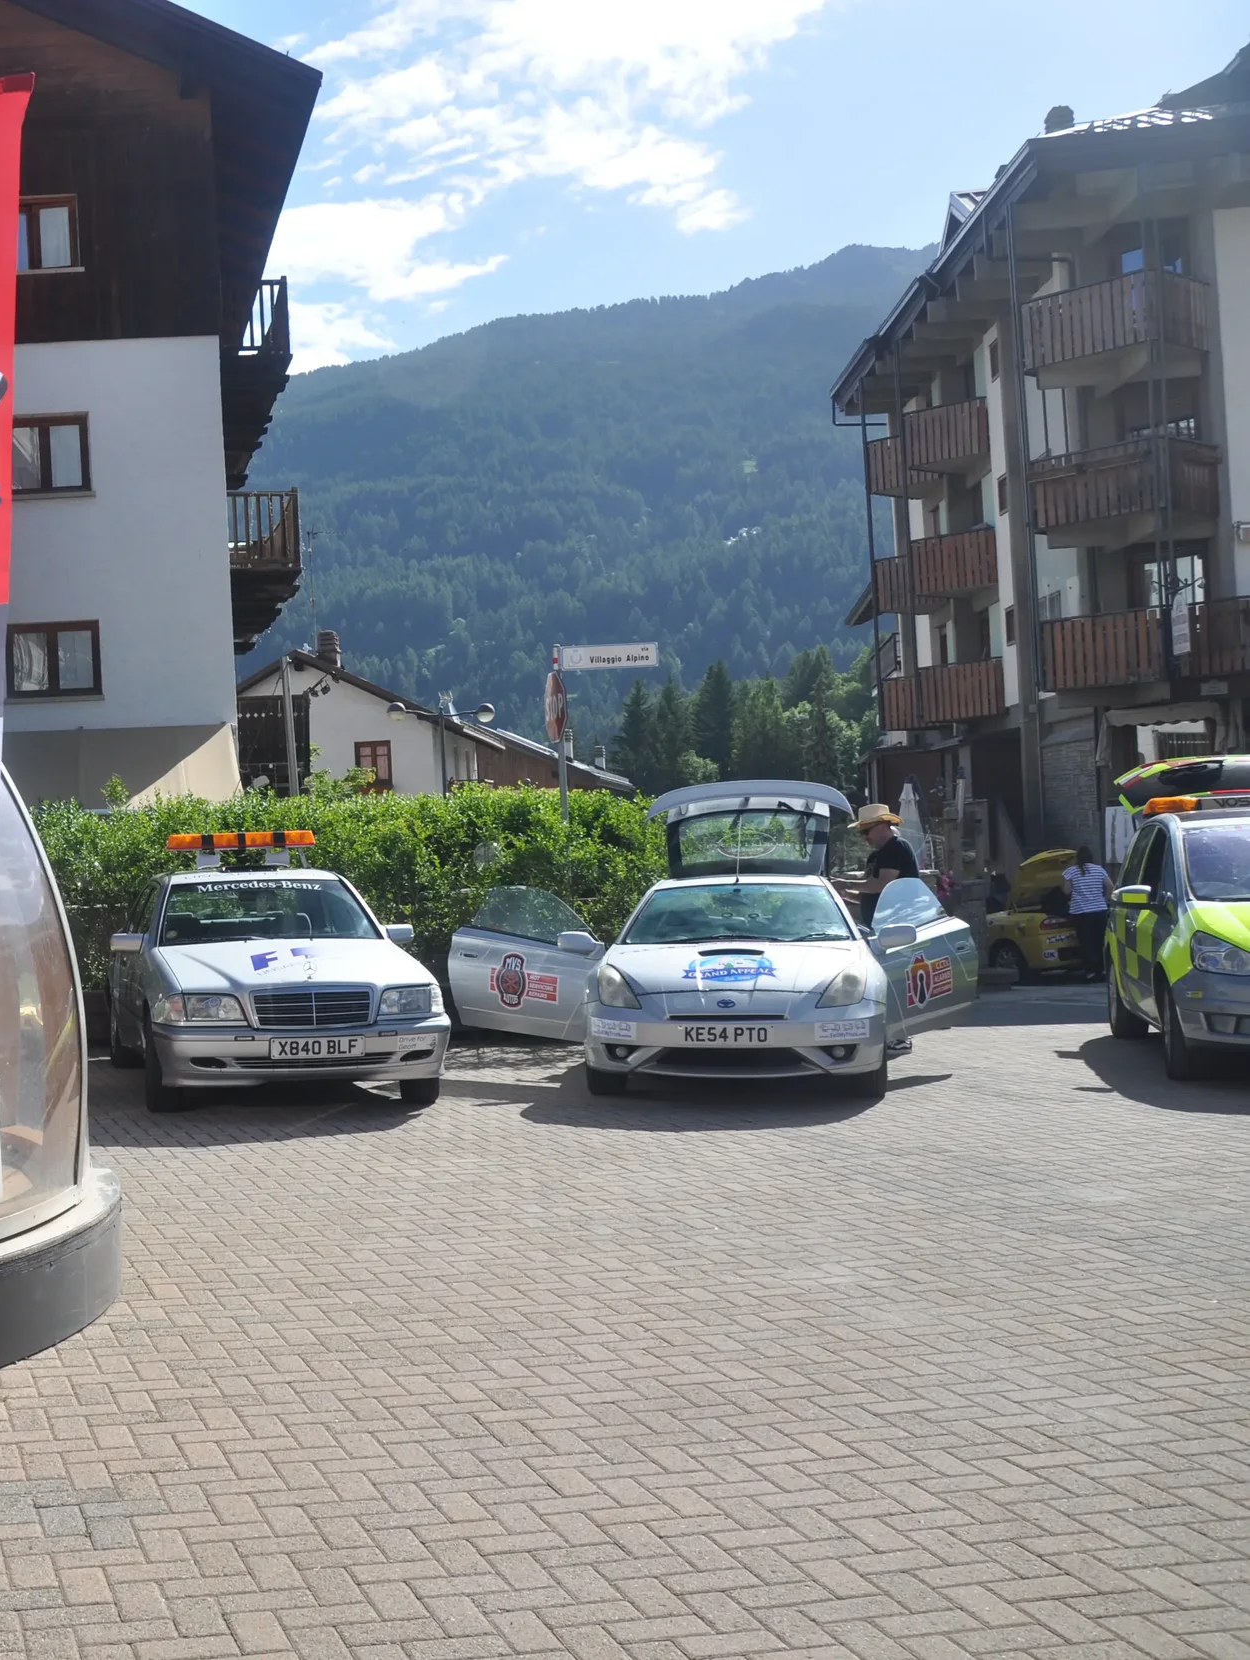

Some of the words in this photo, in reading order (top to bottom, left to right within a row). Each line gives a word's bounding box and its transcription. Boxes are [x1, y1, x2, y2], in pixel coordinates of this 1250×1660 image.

[589, 655, 622, 664] Villaggio
[626, 654, 650, 663] Alpino
[545, 693, 563, 721] STOP
[196, 880, 322, 893] Mercedes-Benz
[506, 957, 522, 971] MVS
[730, 967, 771, 975] APPEAL
[684, 1027, 729, 1042] KE54
[733, 1027, 768, 1042] PTO
[278, 1040, 321, 1056] X840
[326, 1039, 358, 1055] BLF
